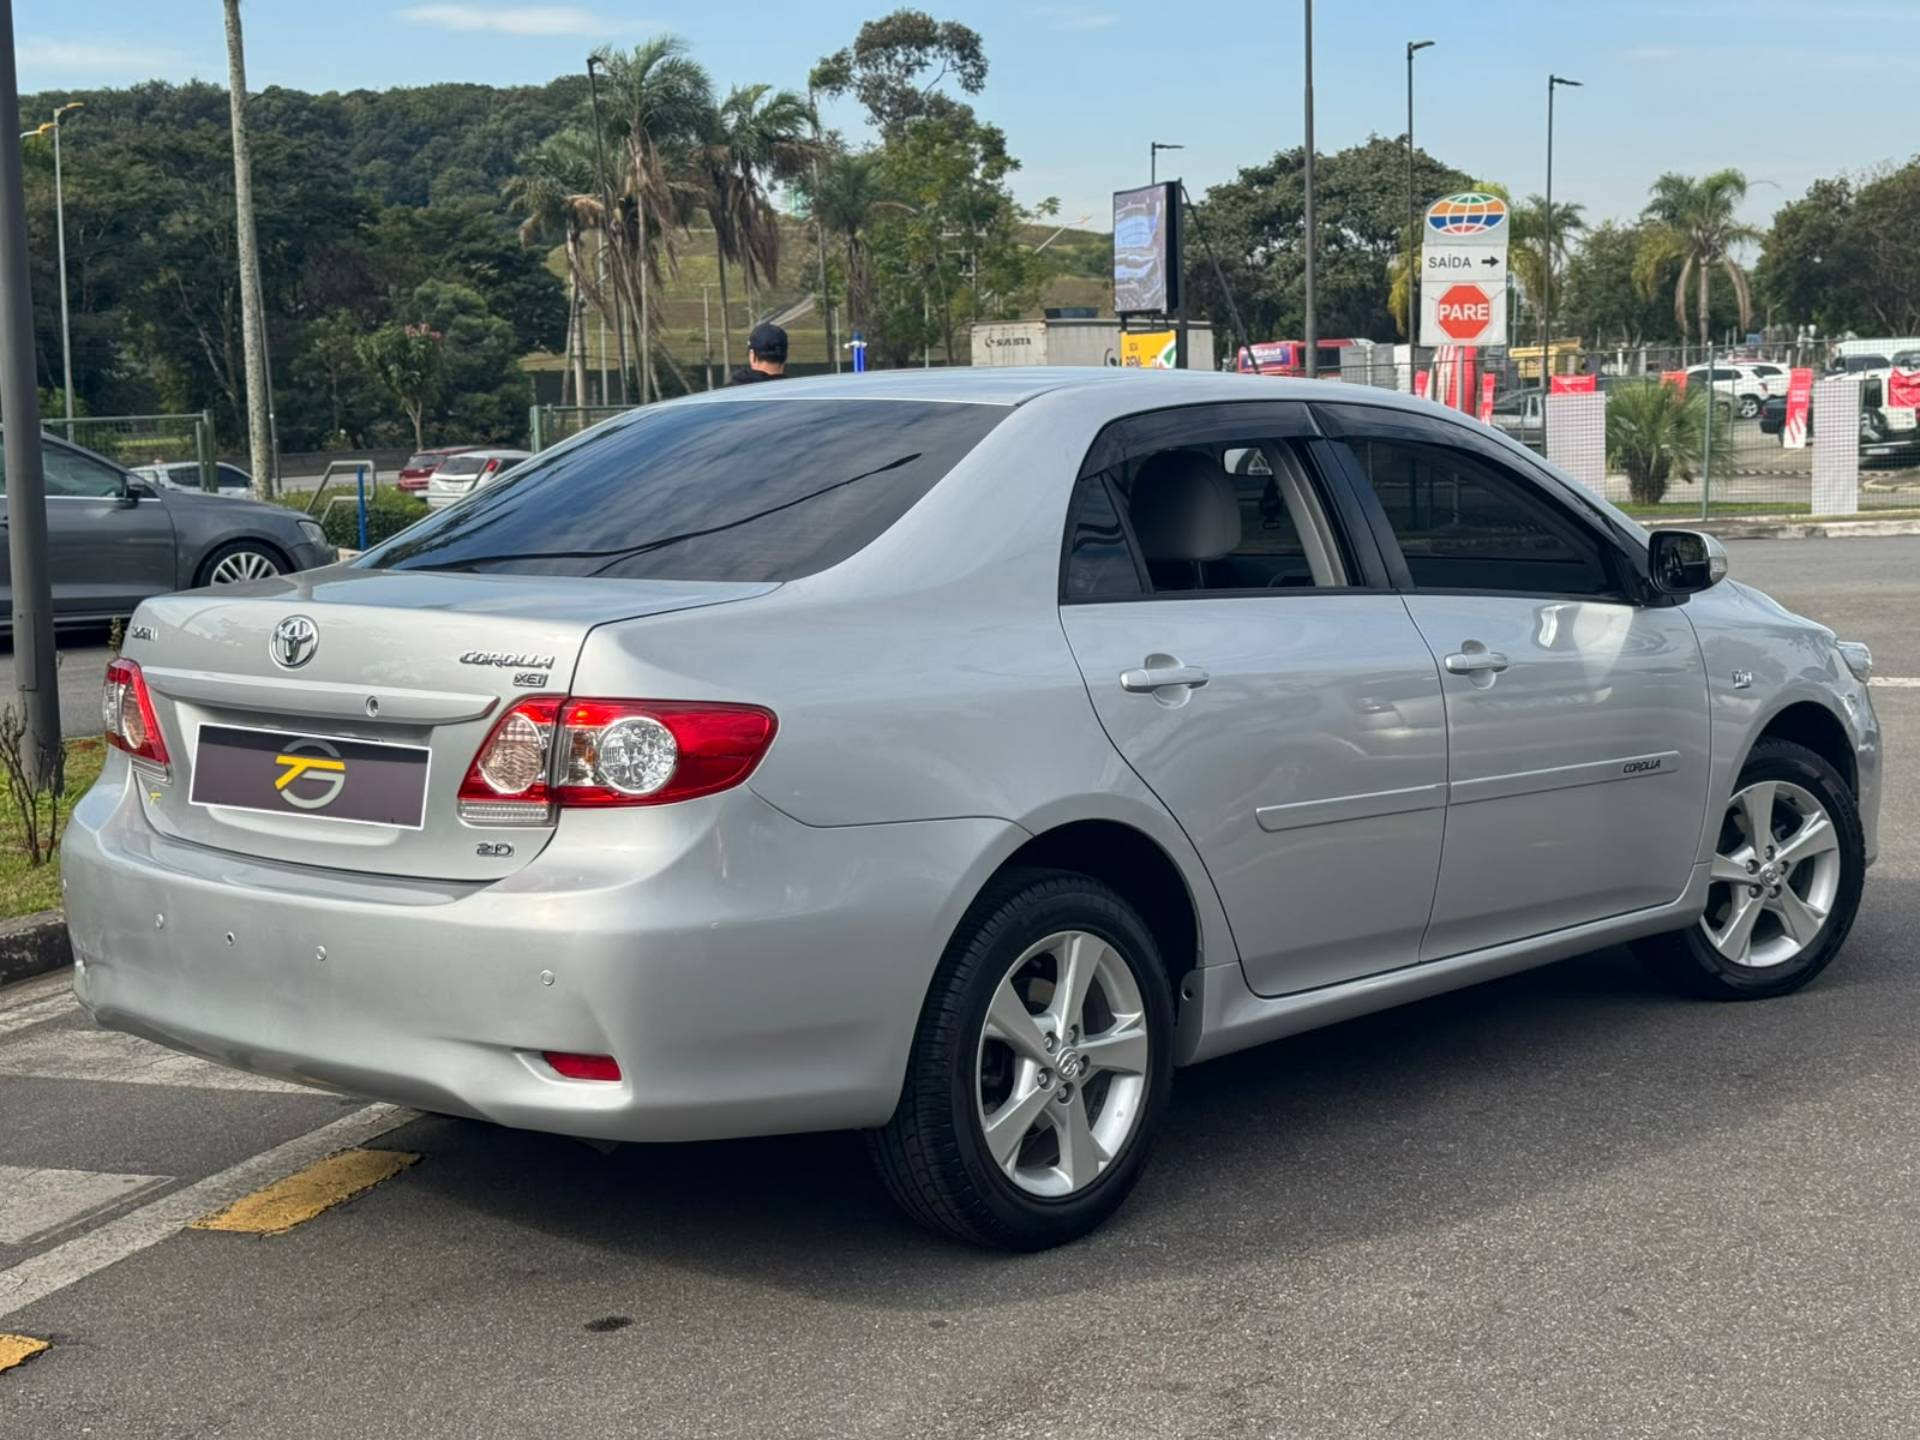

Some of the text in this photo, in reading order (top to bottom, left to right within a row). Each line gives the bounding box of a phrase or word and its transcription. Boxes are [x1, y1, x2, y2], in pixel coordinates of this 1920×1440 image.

[1428, 253, 1472, 269] SAÍDA
[1439, 303, 1489, 321] PARE
[459, 651, 555, 669] COROLLA
[1623, 759, 1661, 773] COROLLA
